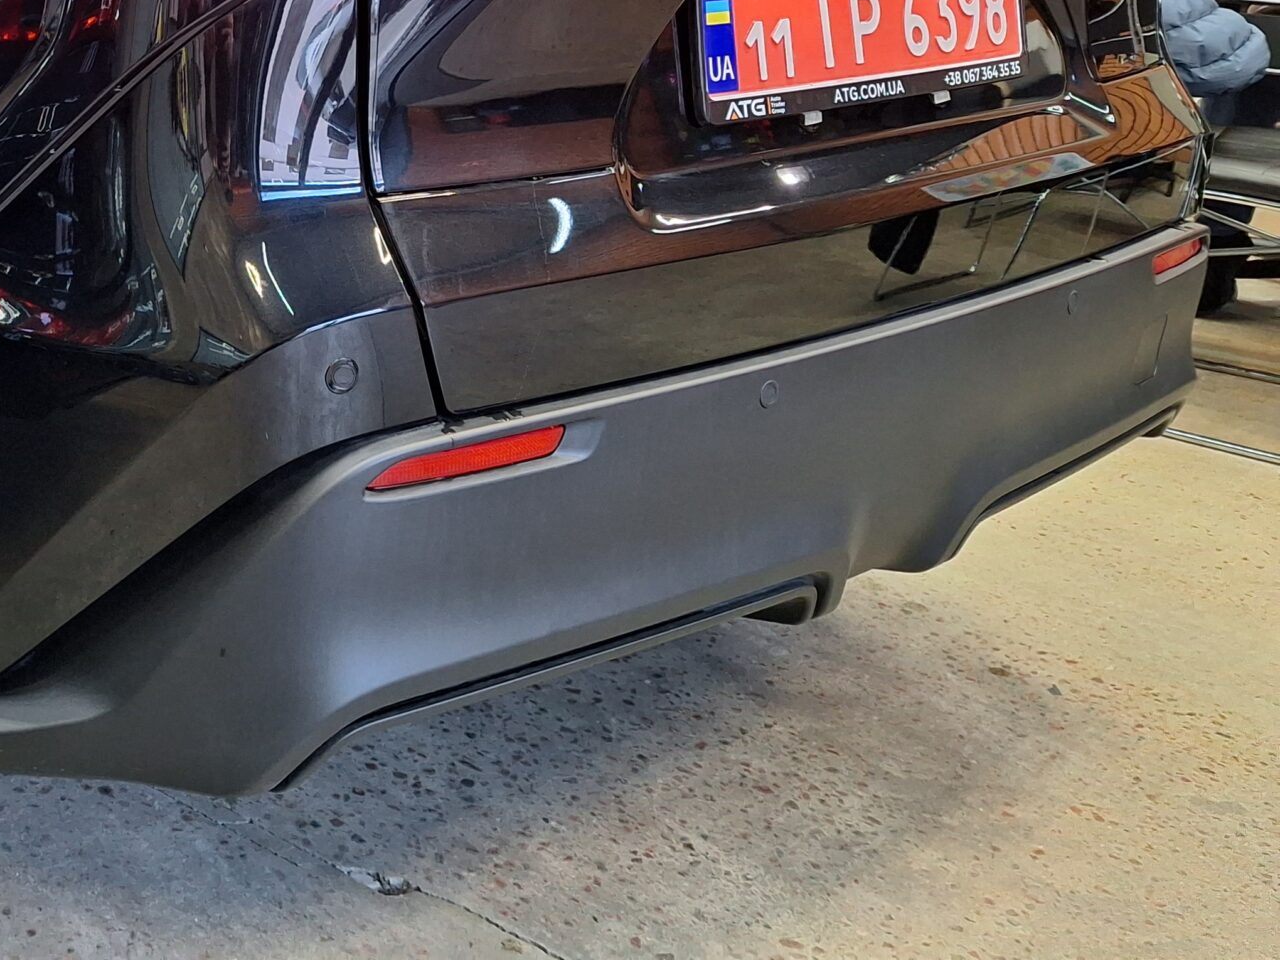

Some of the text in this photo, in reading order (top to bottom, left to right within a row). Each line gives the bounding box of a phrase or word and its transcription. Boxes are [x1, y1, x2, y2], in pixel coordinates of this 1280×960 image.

[745, 18, 796, 82] 11
[708, 54, 735, 82] UA
[944, 60, 1021, 86] +38 067 364 35 35
[833, 79, 906, 104] ATG.COM.UA
[725, 97, 767, 120] ATG
